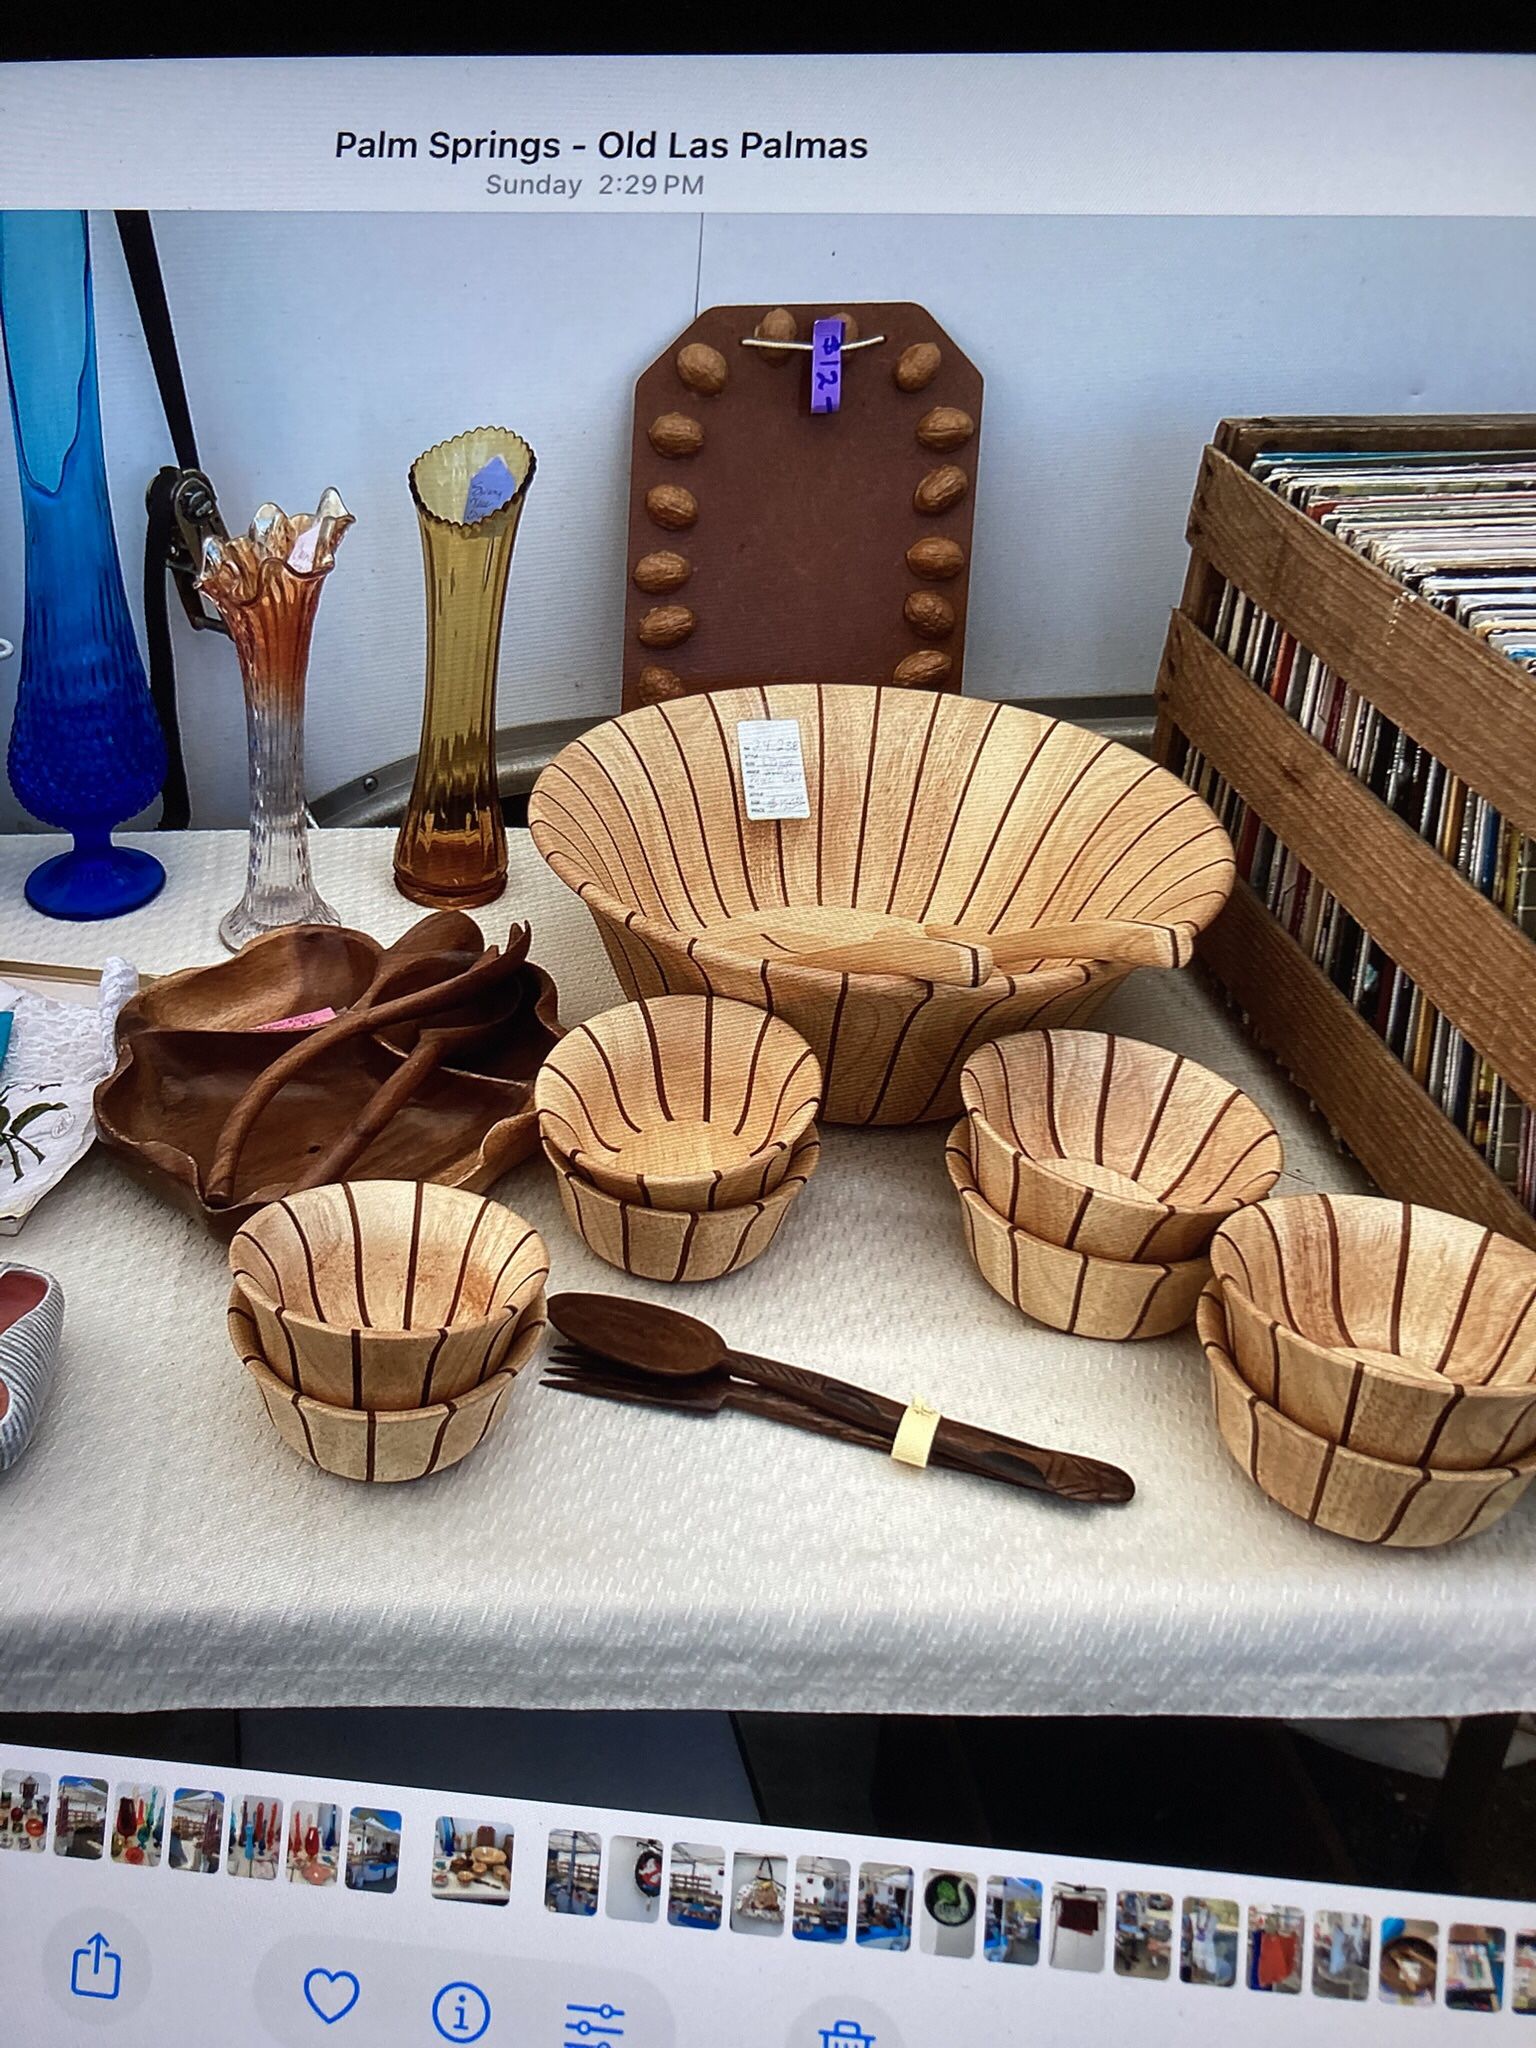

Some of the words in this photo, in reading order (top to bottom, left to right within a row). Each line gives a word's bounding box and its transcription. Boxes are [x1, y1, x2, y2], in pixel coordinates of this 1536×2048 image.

[335, 130, 417, 158] Palm
[428, 129, 560, 165] Springs
[598, 130, 657, 159] Old
[669, 131, 729, 159] Las
[741, 130, 868, 159] Palmas
[485, 173, 583, 200] Sunday
[598, 174, 657, 195] 2:29
[664, 174, 704, 195] PM
